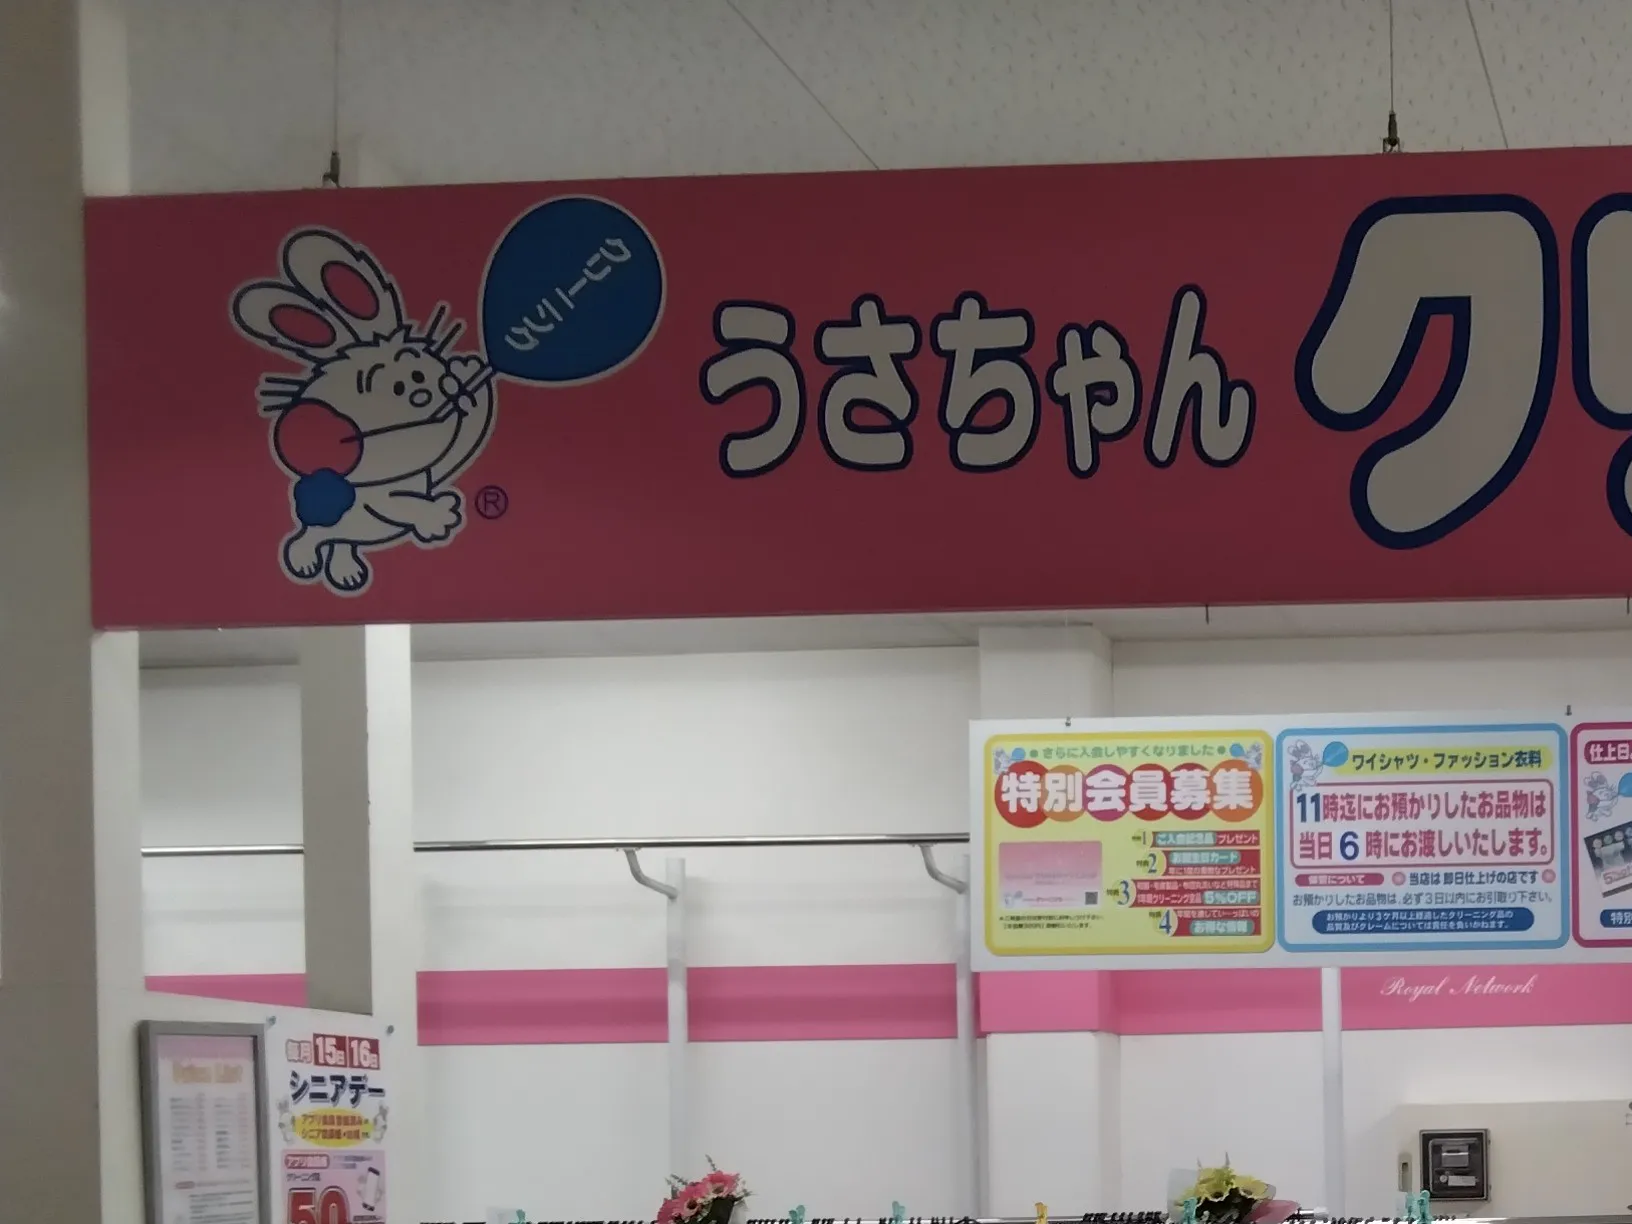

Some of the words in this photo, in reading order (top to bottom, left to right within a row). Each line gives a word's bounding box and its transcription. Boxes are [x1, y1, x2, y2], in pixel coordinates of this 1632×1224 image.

[703, 286, 1255, 477] うさちゃん
[1001, 767, 1254, 813] 特別会員募集
[1296, 790, 1547, 823] 11時迄にお預かりしたお品物は
[1380, 976, 1449, 1002] Royal
[1450, 974, 1538, 996] Network
[289, 1070, 386, 1108] シニアデー
